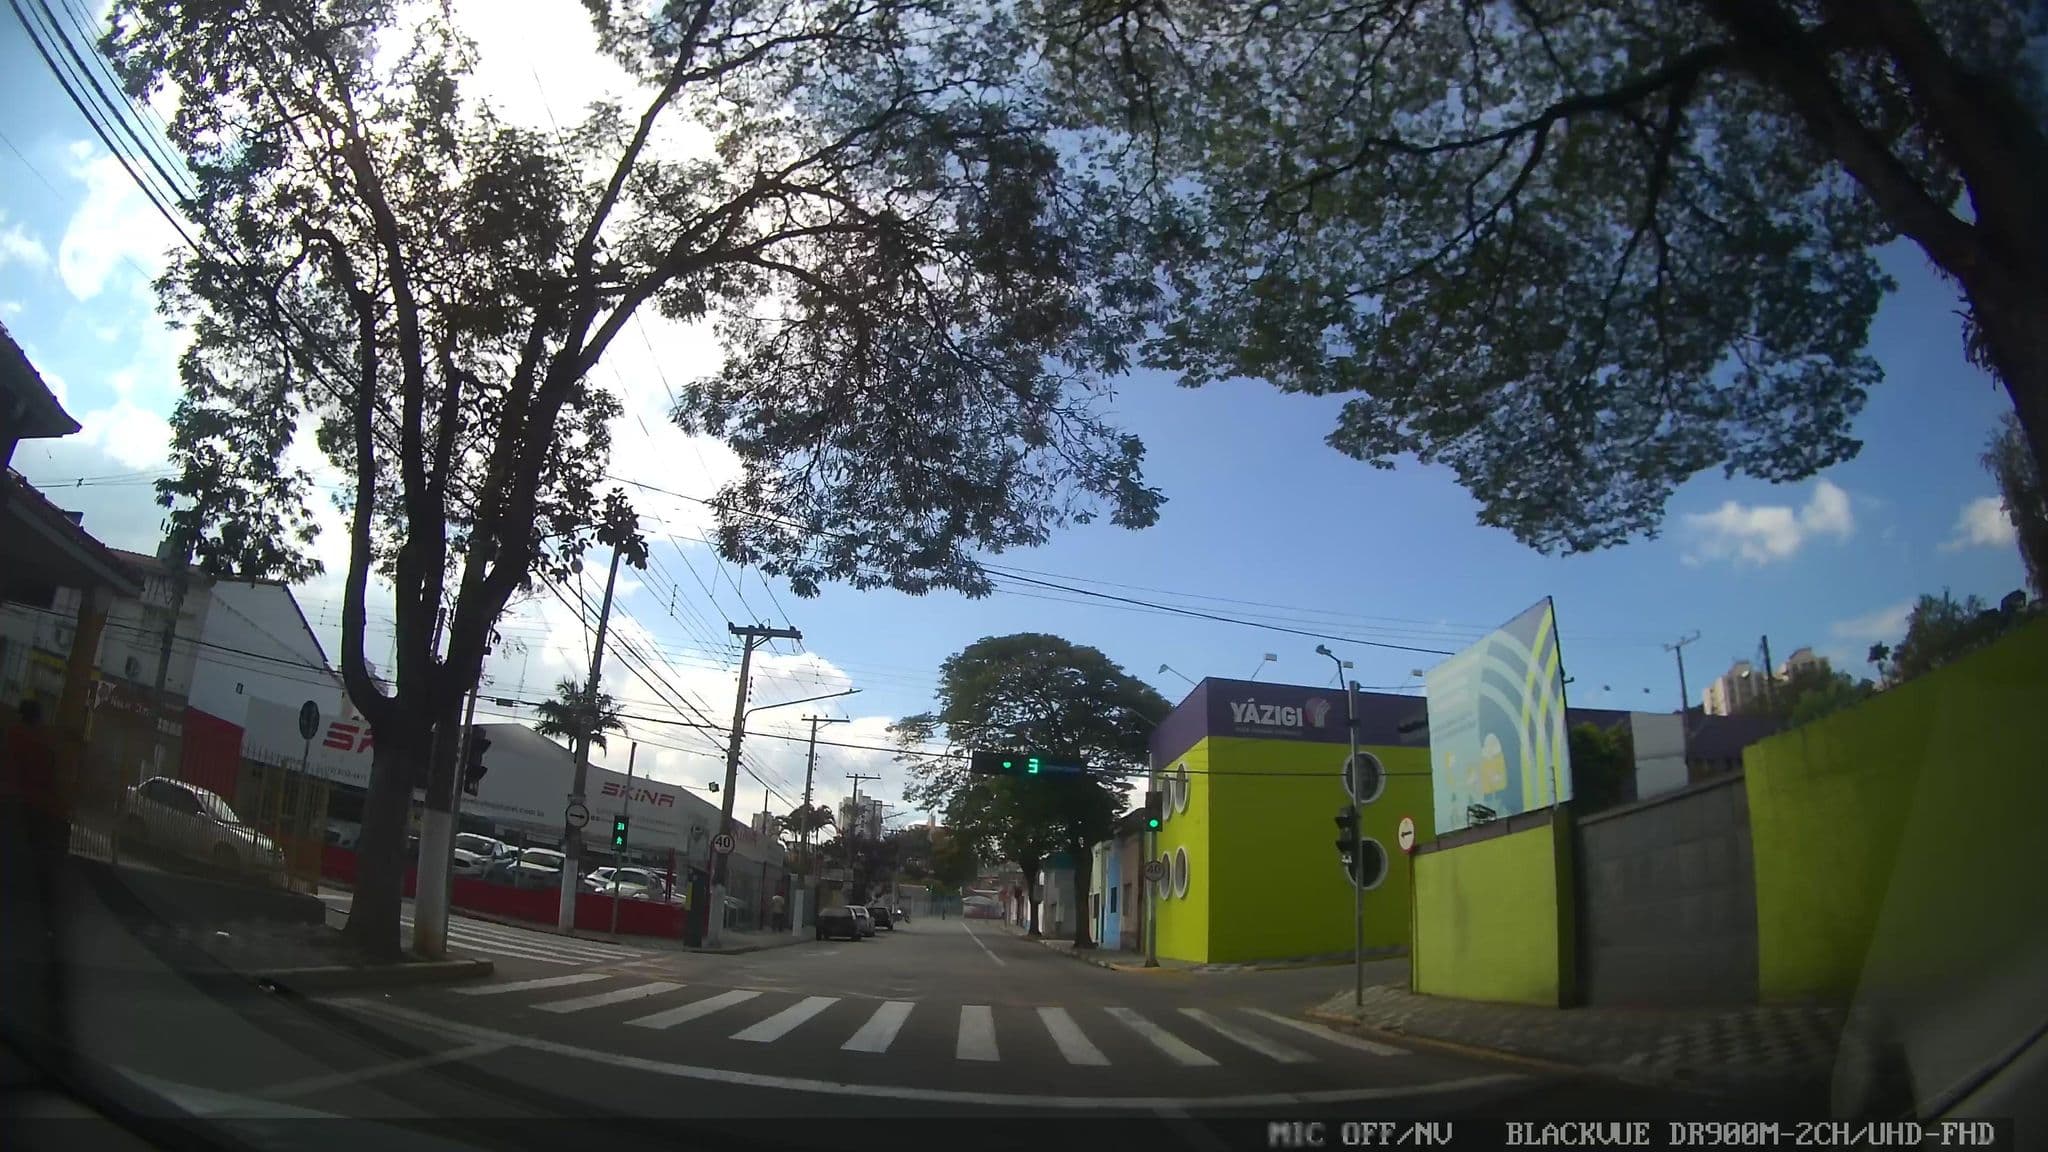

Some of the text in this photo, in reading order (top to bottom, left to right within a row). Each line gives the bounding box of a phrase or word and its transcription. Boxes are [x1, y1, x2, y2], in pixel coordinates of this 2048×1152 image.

[1229, 697, 1304, 728] YÁZIGI
[1028, 758, 1039, 774] 3
[716, 837, 731, 848] 40
[1146, 864, 1161, 874] 40
